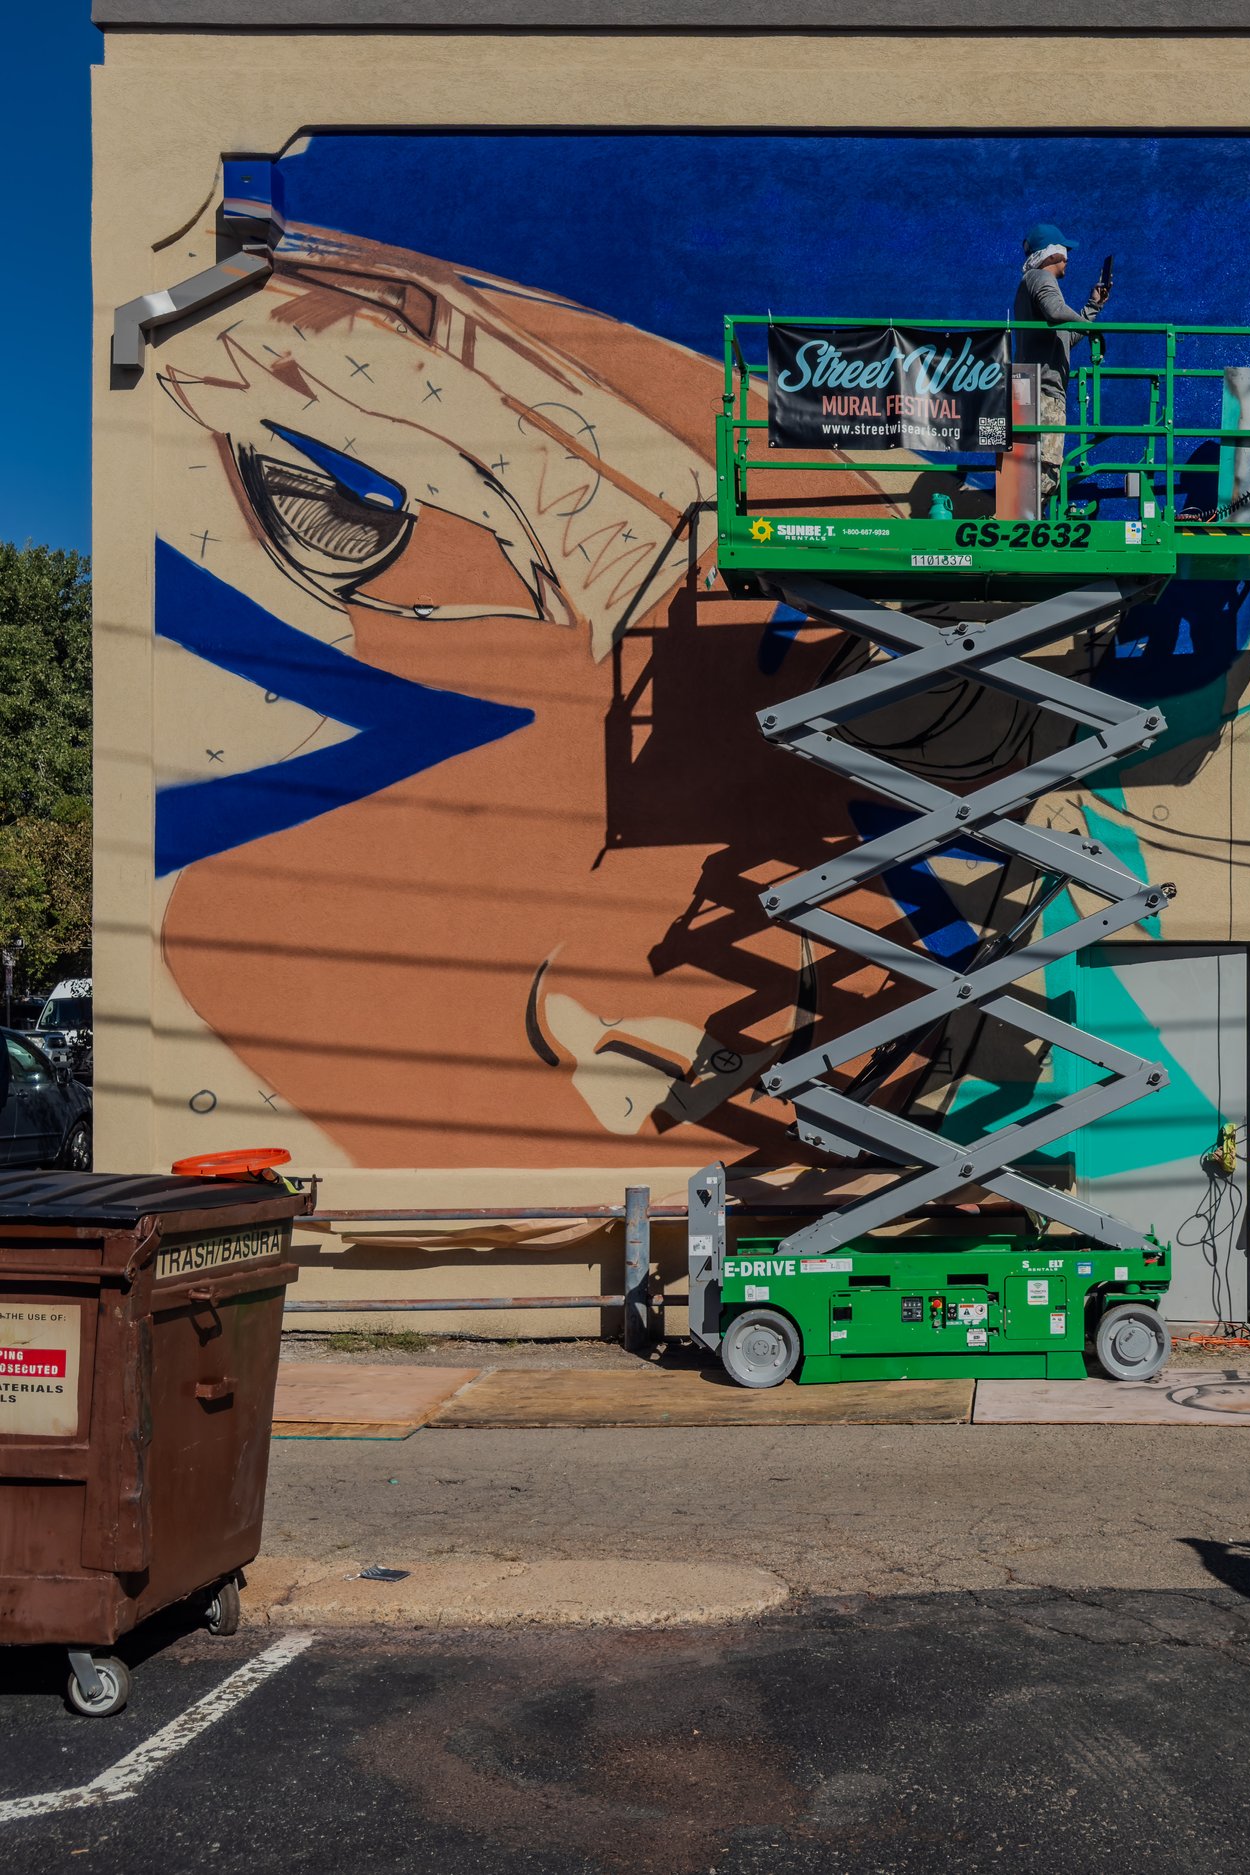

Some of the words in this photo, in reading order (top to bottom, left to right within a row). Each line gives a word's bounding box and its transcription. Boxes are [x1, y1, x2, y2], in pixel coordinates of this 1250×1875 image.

[777, 339, 905, 392] Street
[902, 337, 1003, 394] Wise
[822, 395, 882, 416] MURAL
[886, 394, 961, 419] FESTIVAL
[822, 421, 961, 439] www.streetwisearts.org
[777, 525, 835, 536] SUNBET
[955, 522, 1092, 548] GS-2632
[158, 1228, 280, 1275] TRASH/BASURA
[724, 1260, 796, 1277] E-DRIVE
[1022, 1259, 1064, 1269] SELT
[6, 1312, 24, 1320] THE
[27, 1313, 47, 1321] USE
[0, 1383, 64, 1394] TERIALS
